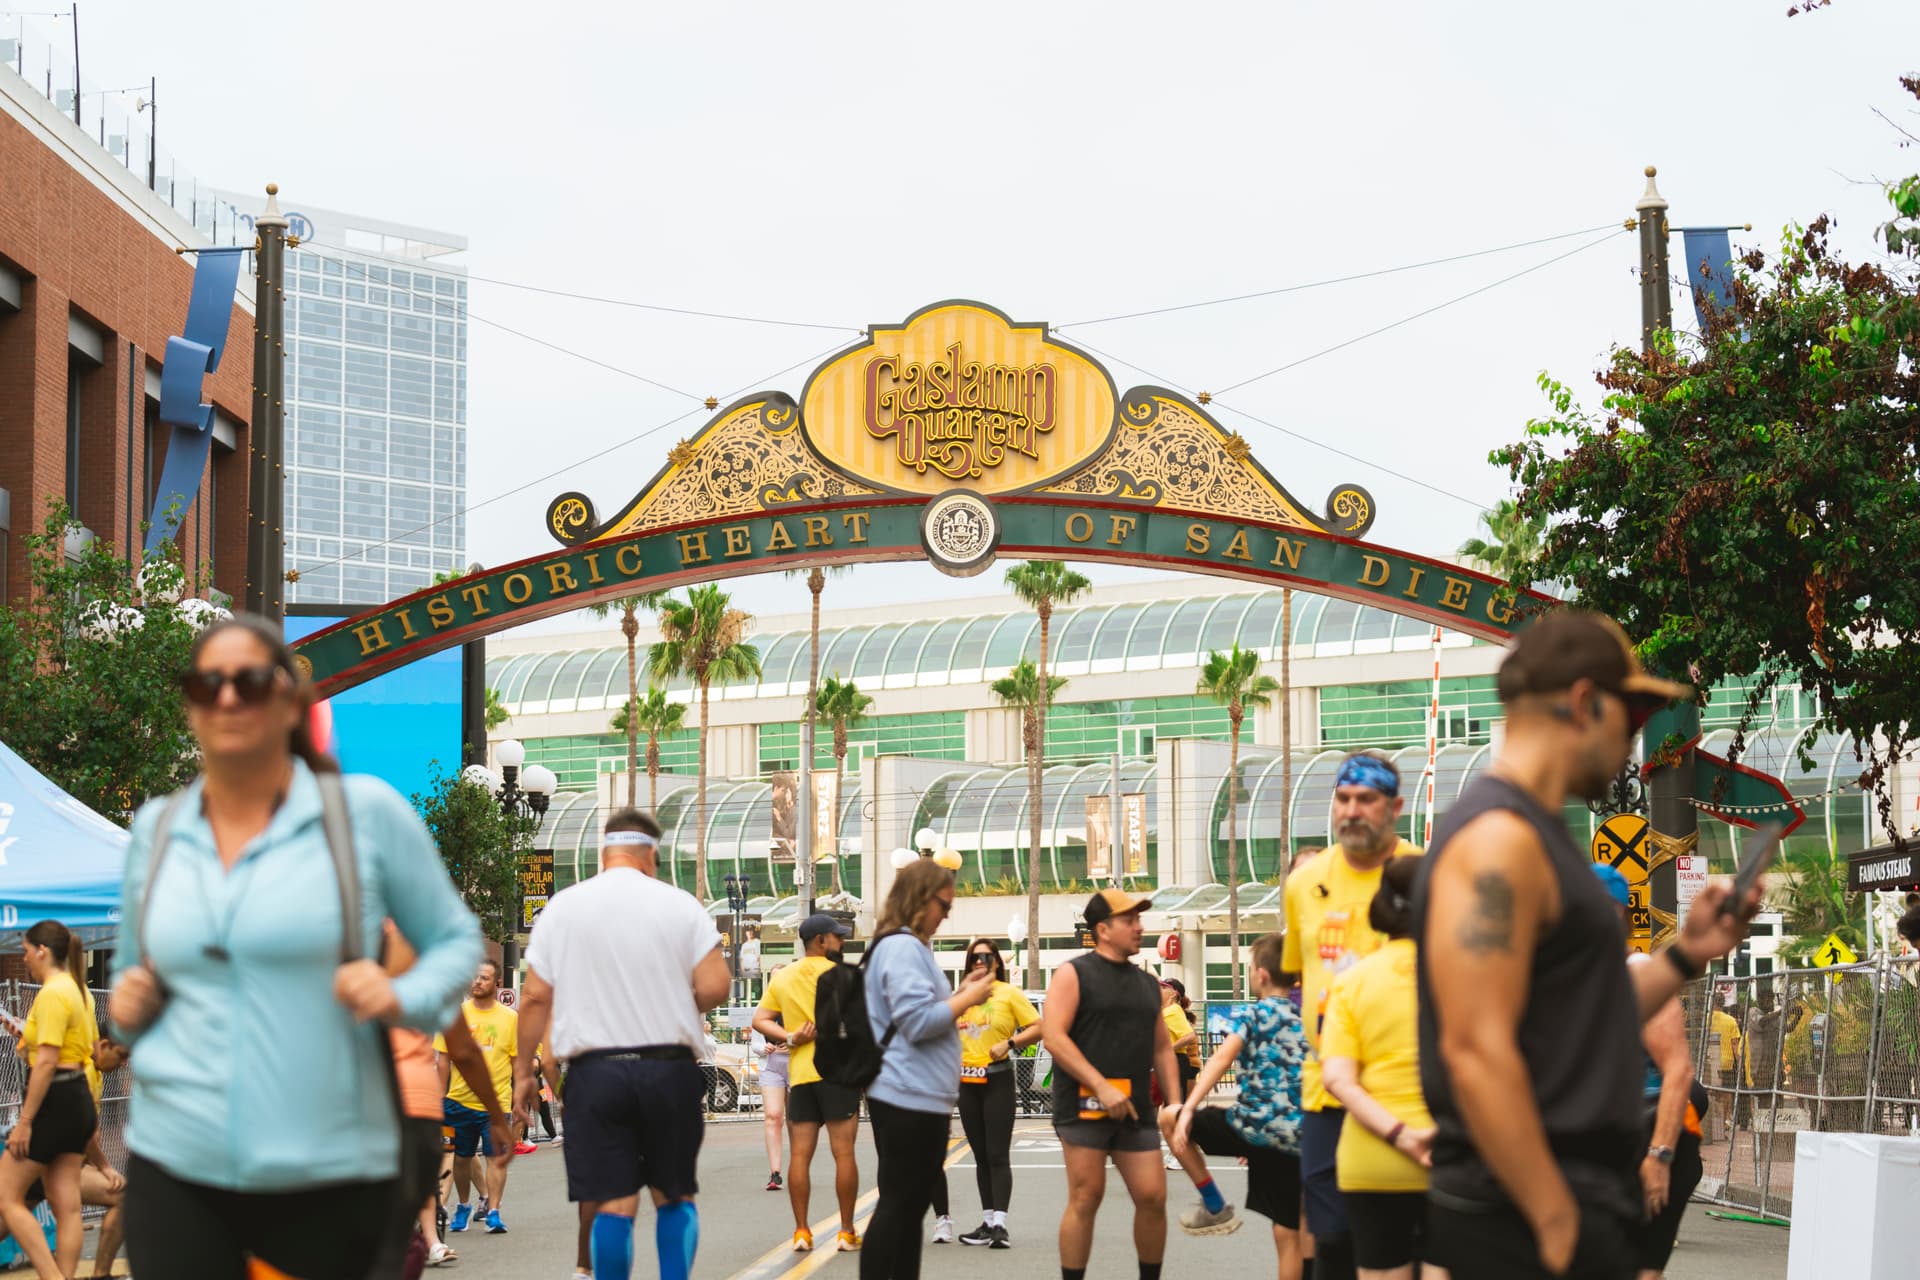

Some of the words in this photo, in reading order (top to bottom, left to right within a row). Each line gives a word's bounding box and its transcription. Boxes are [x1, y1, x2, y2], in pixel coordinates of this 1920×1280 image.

[864, 341, 1057, 458] Gaslamp
[897, 409, 1027, 478] Quarter
[352, 544, 643, 656] HISTORIC
[676, 512, 870, 564] HEART
[1065, 512, 1136, 545] OF
[1185, 523, 1307, 569] SAN
[1357, 555, 1516, 625] DIEG
[818, 775, 830, 837] STARZ
[1128, 797, 1140, 853] STARZ
[1598, 843, 1611, 860] R
[1680, 858, 1690, 869] NO
[1859, 862, 1886, 883] FAMOUS
[1886, 857, 1911, 879] STEAKS
[1680, 872, 1704, 880] PARKING
[1170, 939, 1177, 955] F
